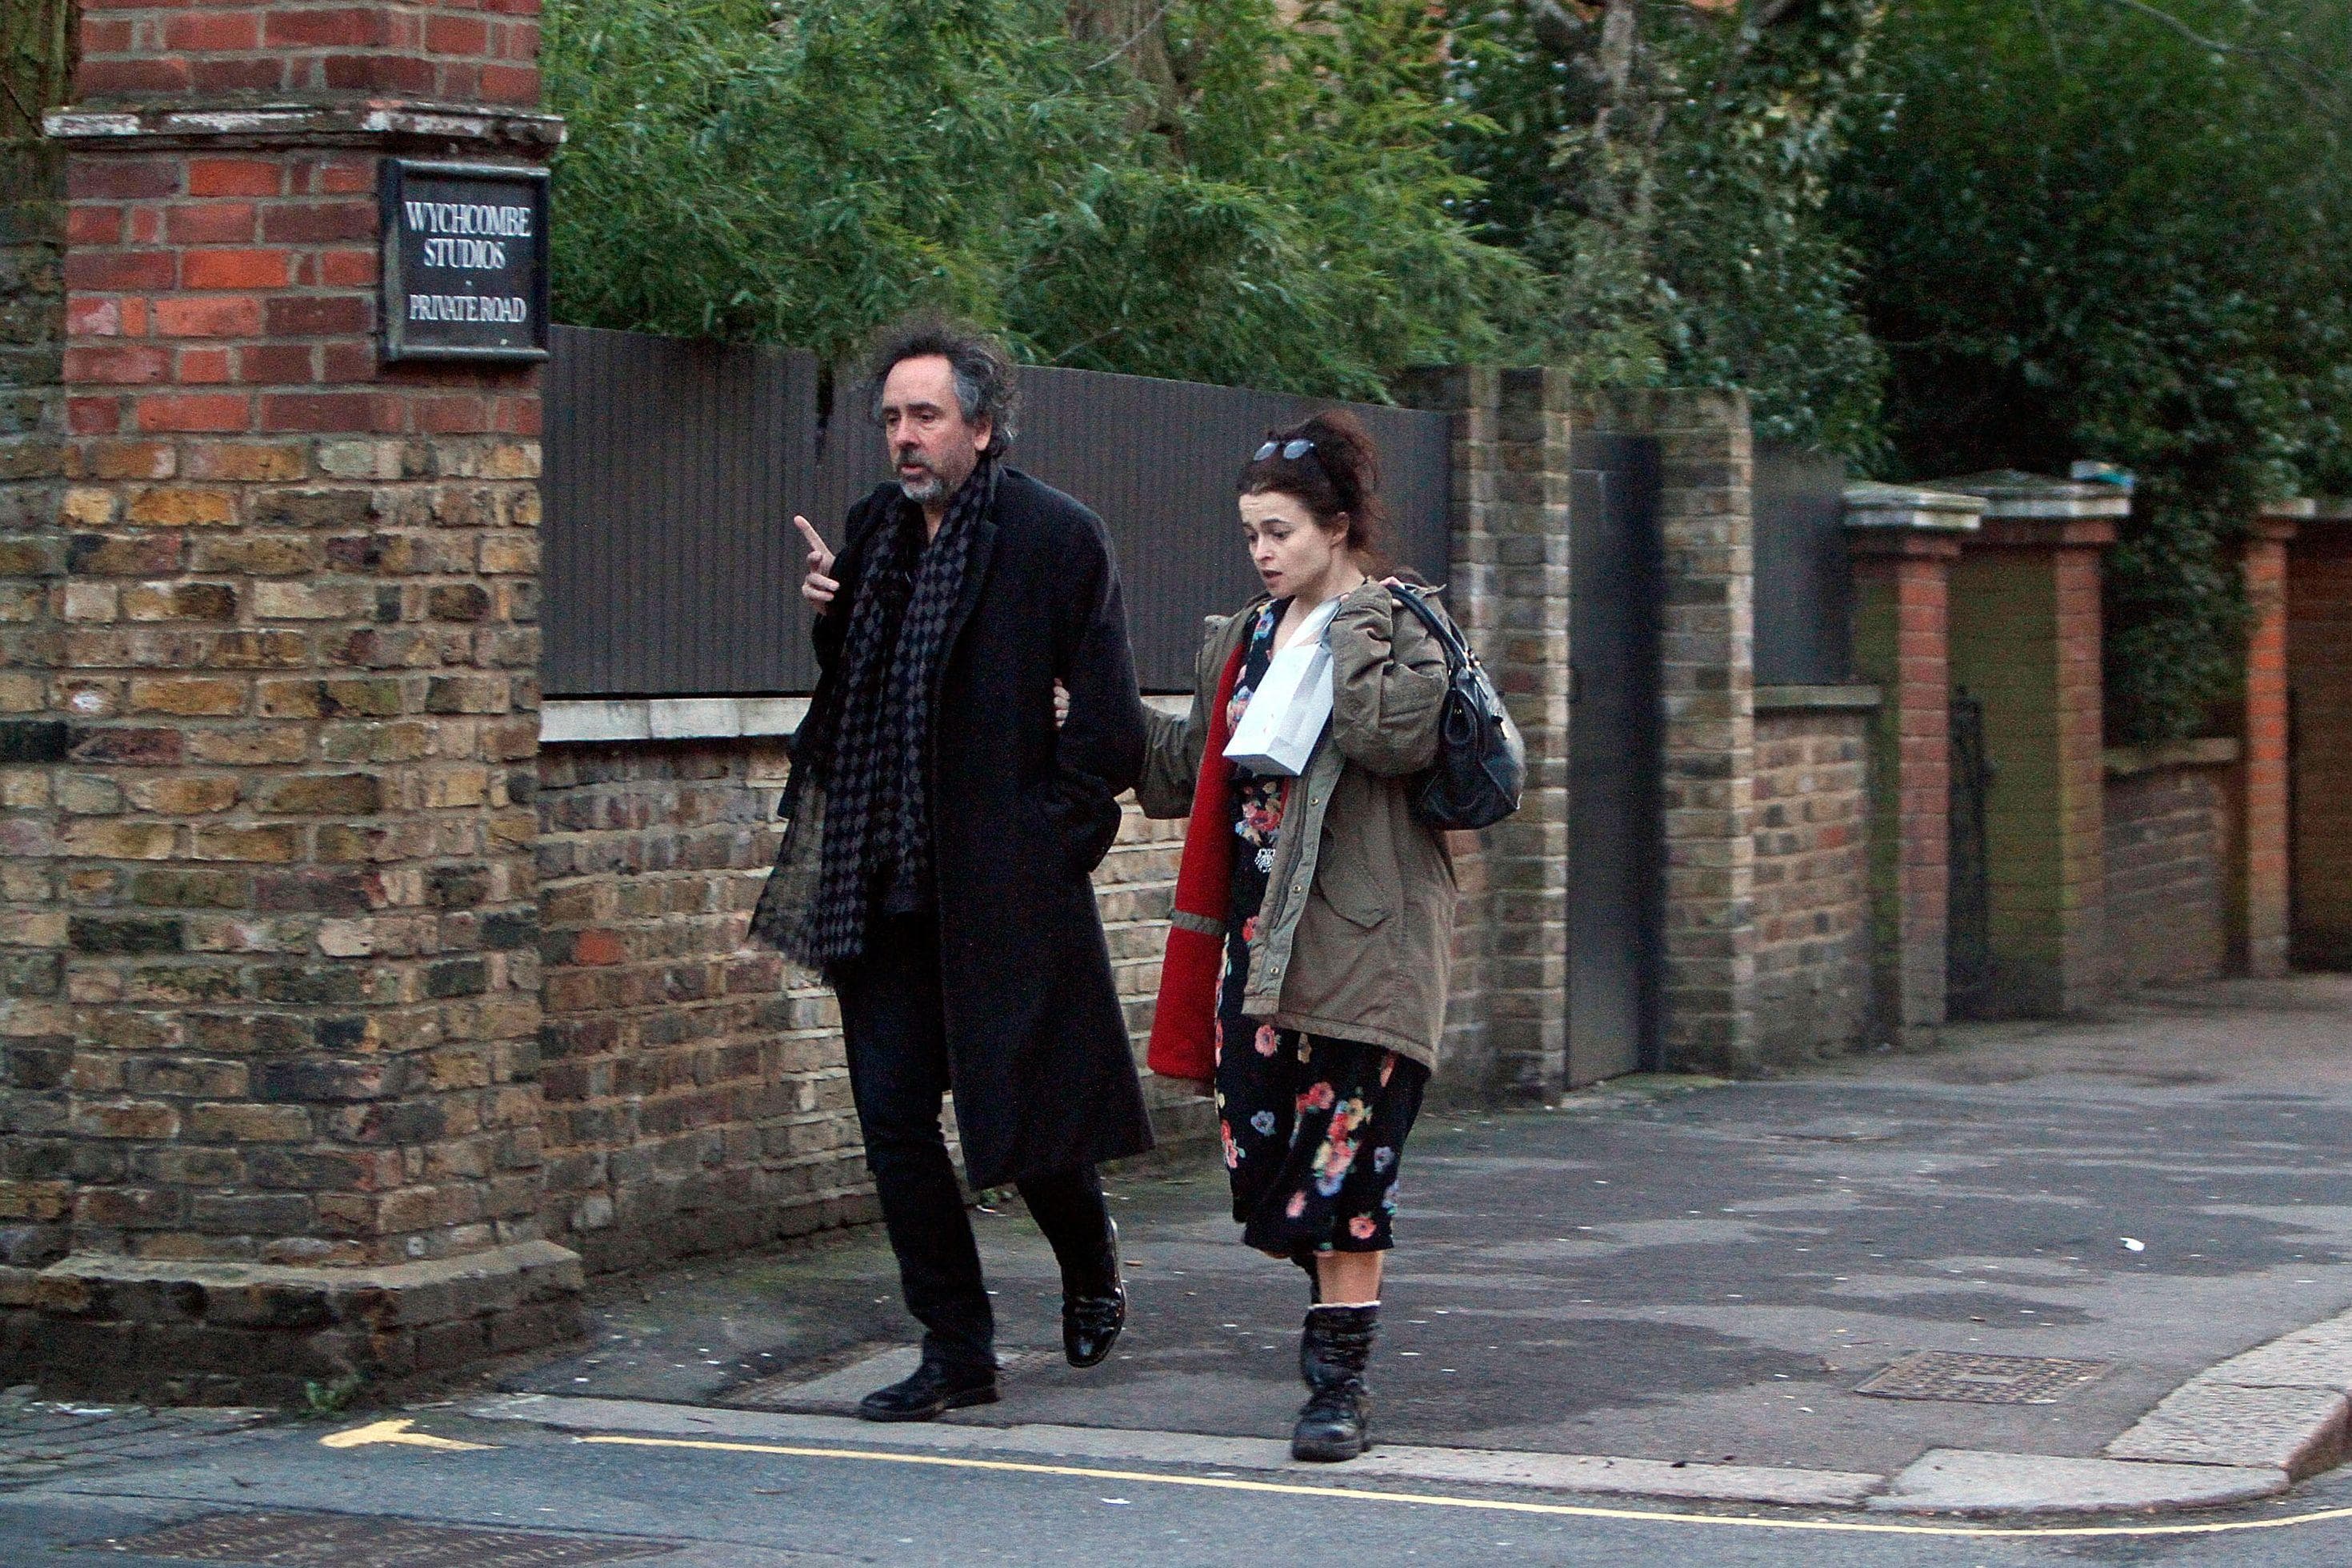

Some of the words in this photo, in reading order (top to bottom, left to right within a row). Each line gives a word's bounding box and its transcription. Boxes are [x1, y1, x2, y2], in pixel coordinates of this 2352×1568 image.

[405, 201, 532, 237] WYCHCOMBE
[423, 238, 506, 270] STUDIOS
[409, 294, 479, 322] PRIVATE
[479, 296, 527, 323] ROAD
